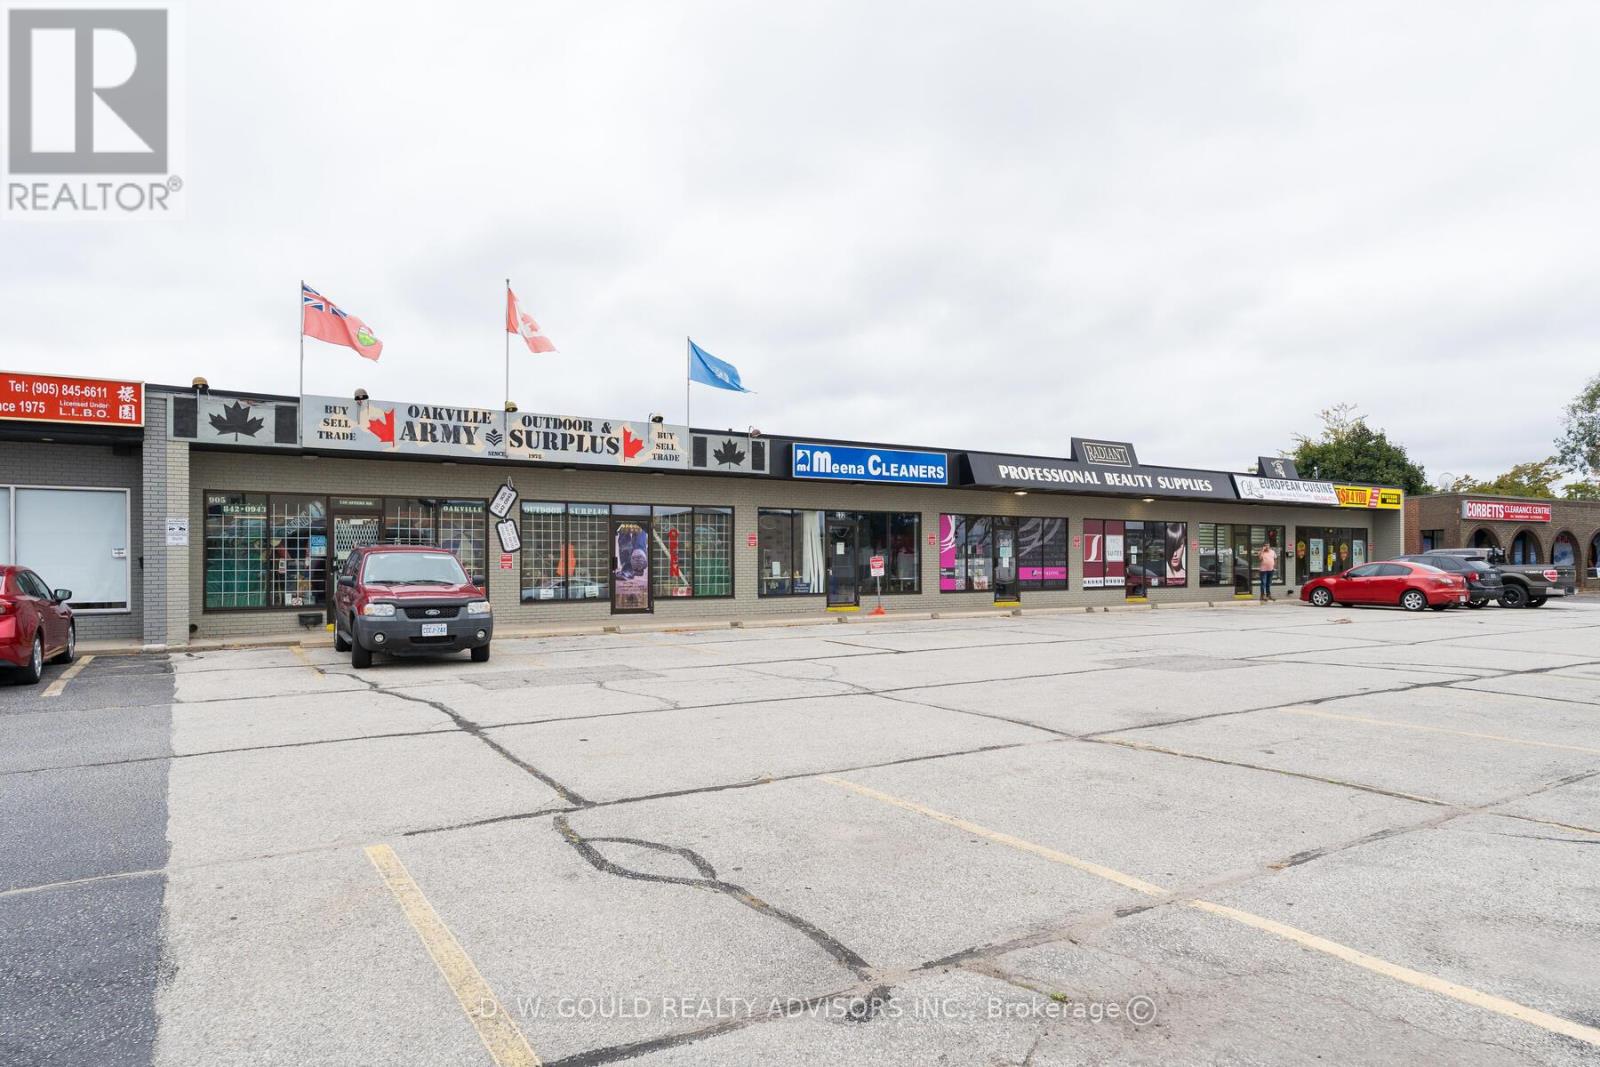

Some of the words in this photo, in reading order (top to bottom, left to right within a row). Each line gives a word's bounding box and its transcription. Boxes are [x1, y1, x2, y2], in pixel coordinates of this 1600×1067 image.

[9, 380, 28, 393] Tel:
[32, 382, 59, 398] (905)
[62, 385, 107, 399] 845-6611
[19, 401, 46, 414] 1975
[59, 400, 88, 408] Licensed
[324, 405, 349, 415] BUY
[59, 407, 110, 418] L.L.B.O.
[408, 404, 492, 424] OAKVILLE
[323, 418, 351, 428] SELL
[521, 414, 593, 433] OUTDOOR
[601, 421, 612, 435] &
[317, 430, 357, 441] TRADE
[400, 420, 480, 446] ARMY
[657, 431, 675, 440] BUY
[509, 429, 620, 456] SURPLUS
[656, 442, 676, 451] SELL
[652, 453, 680, 462] TRADE
[1086, 445, 1127, 463] RADIANT
[998, 464, 1101, 485] PROFESSIONAL
[1104, 473, 1152, 488] BEAUTY
[1157, 476, 1213, 492] SUPPLIES
[1259, 479, 1300, 491] EUROPEAN
[1303, 482, 1335, 494] CUISINE
[443, 505, 483, 513] OAKVILLE
[569, 507, 609, 515] SURPLUS
[1466, 502, 1504, 518] CORBETTS
[1504, 505, 1532, 514] CLEARANCE
[1532, 506, 1551, 515] CENTRE
